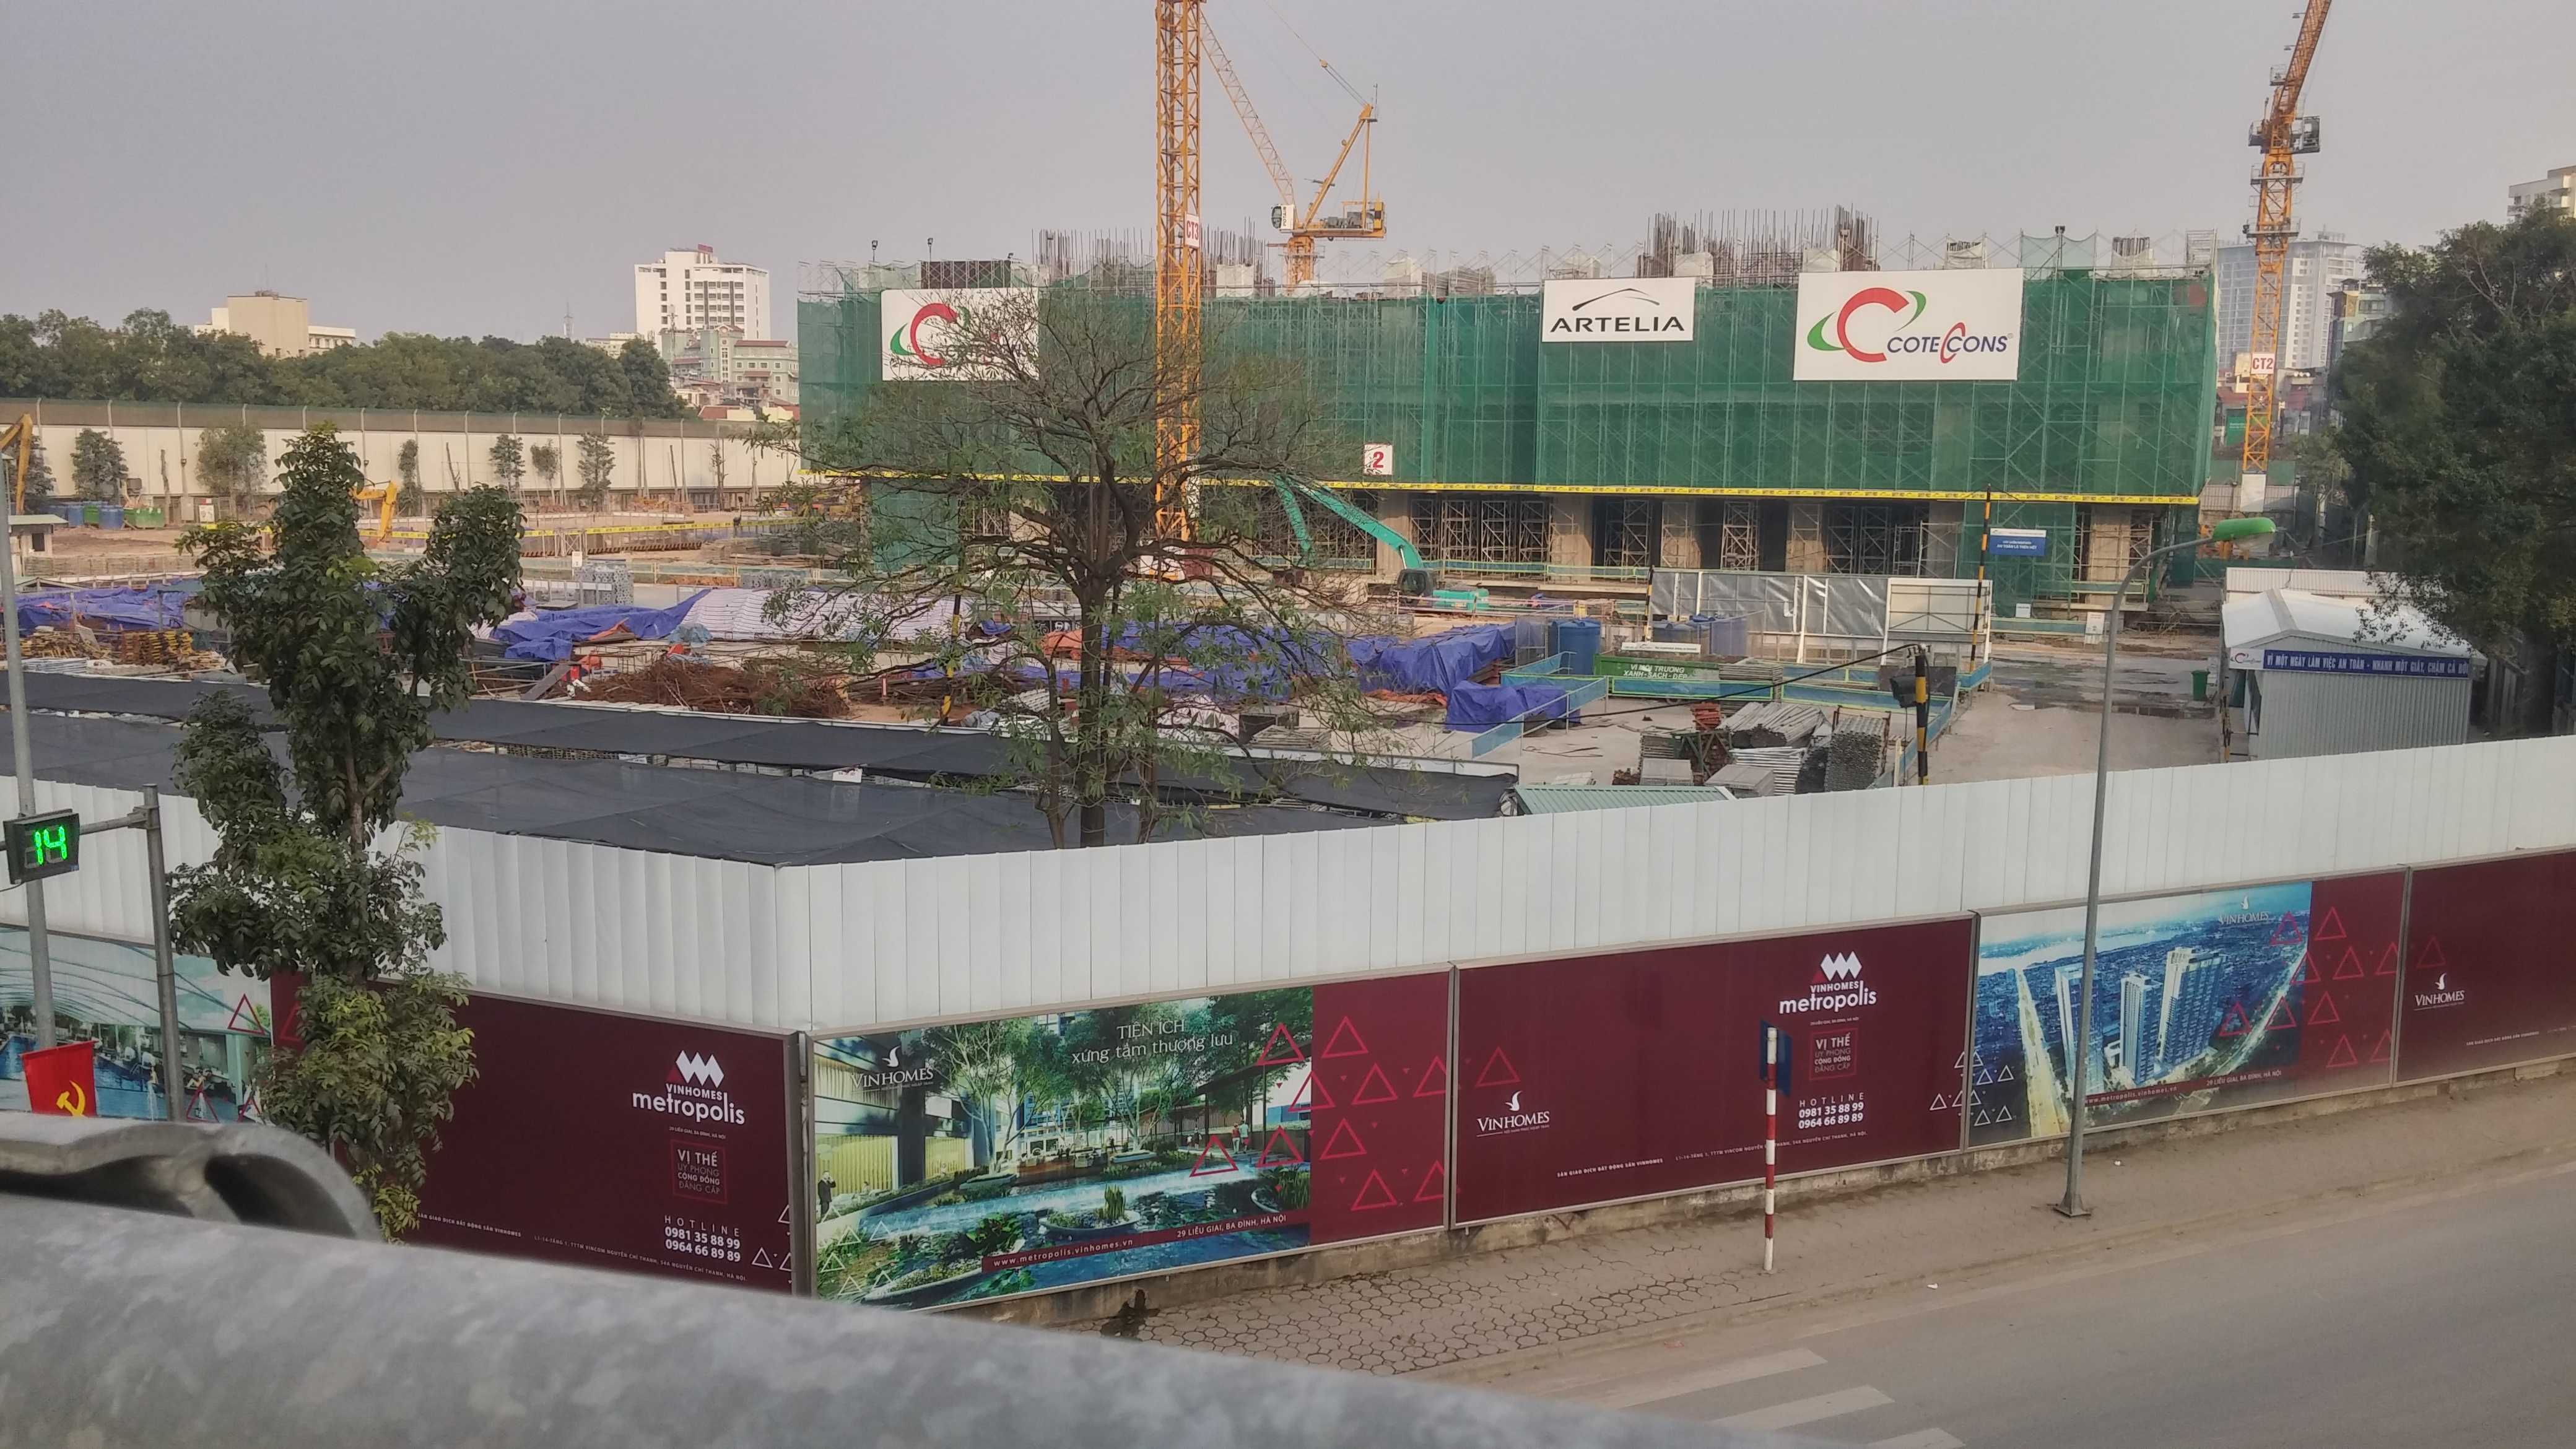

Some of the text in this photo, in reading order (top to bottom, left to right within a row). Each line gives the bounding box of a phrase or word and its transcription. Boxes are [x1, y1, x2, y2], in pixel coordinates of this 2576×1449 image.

[1186, 220, 1199, 241] CT3
[1550, 316, 1685, 333] ARTELIA
[2252, 357, 2274, 370] CT2
[1372, 451, 1384, 468] 2
[2276, 654, 2288, 667] MỘT
[2291, 655, 2305, 667] NGÀY
[2308, 655, 2320, 668] LÀM
[2323, 655, 2336, 670] VIỆC
[2338, 658, 2347, 669] AN
[2349, 657, 2364, 669] TOÀN
[2372, 659, 2392, 671] NHANH
[2395, 659, 2408, 674] MỘT
[35, 826, 67, 864] 14
[2219, 911, 2269, 925] VINHOMES
[1810, 981, 1859, 993] VINHOMES
[1779, 980, 1877, 1014] metropolis
[2415, 990, 2465, 1006] VINHOMES
[1072, 1047, 1110, 1064] xứng
[1152, 1036, 1206, 1055] thượng
[1211, 1033, 1234, 1047] lưu
[1831, 1032, 1851, 1048] THẾ
[851, 1067, 934, 1089] VINHOMES
[665, 1083, 723, 1101] VINHOMES
[633, 1092, 745, 1125] metropolis
[1799, 1102, 1864, 1118] 0981 35 88 99
[1477, 1111, 1550, 1131] VINHOMES
[1798, 1113, 1863, 1129] 0964 66 89 89
[677, 1149, 718, 1167] VỊ THẾ
[1637, 1157, 1663, 1167] VINHOMES
[1261, 1214, 1271, 1224] HÀ
[1273, 1214, 1286, 1224] NỘI
[495, 1227, 521, 1237] VINHOMES
[664, 1226, 740, 1249] 0981 35 88 99
[666, 1238, 741, 1262] 0964 66 89 89
[993, 1239, 1134, 1267] www.metropolis.vinhomes.vn
